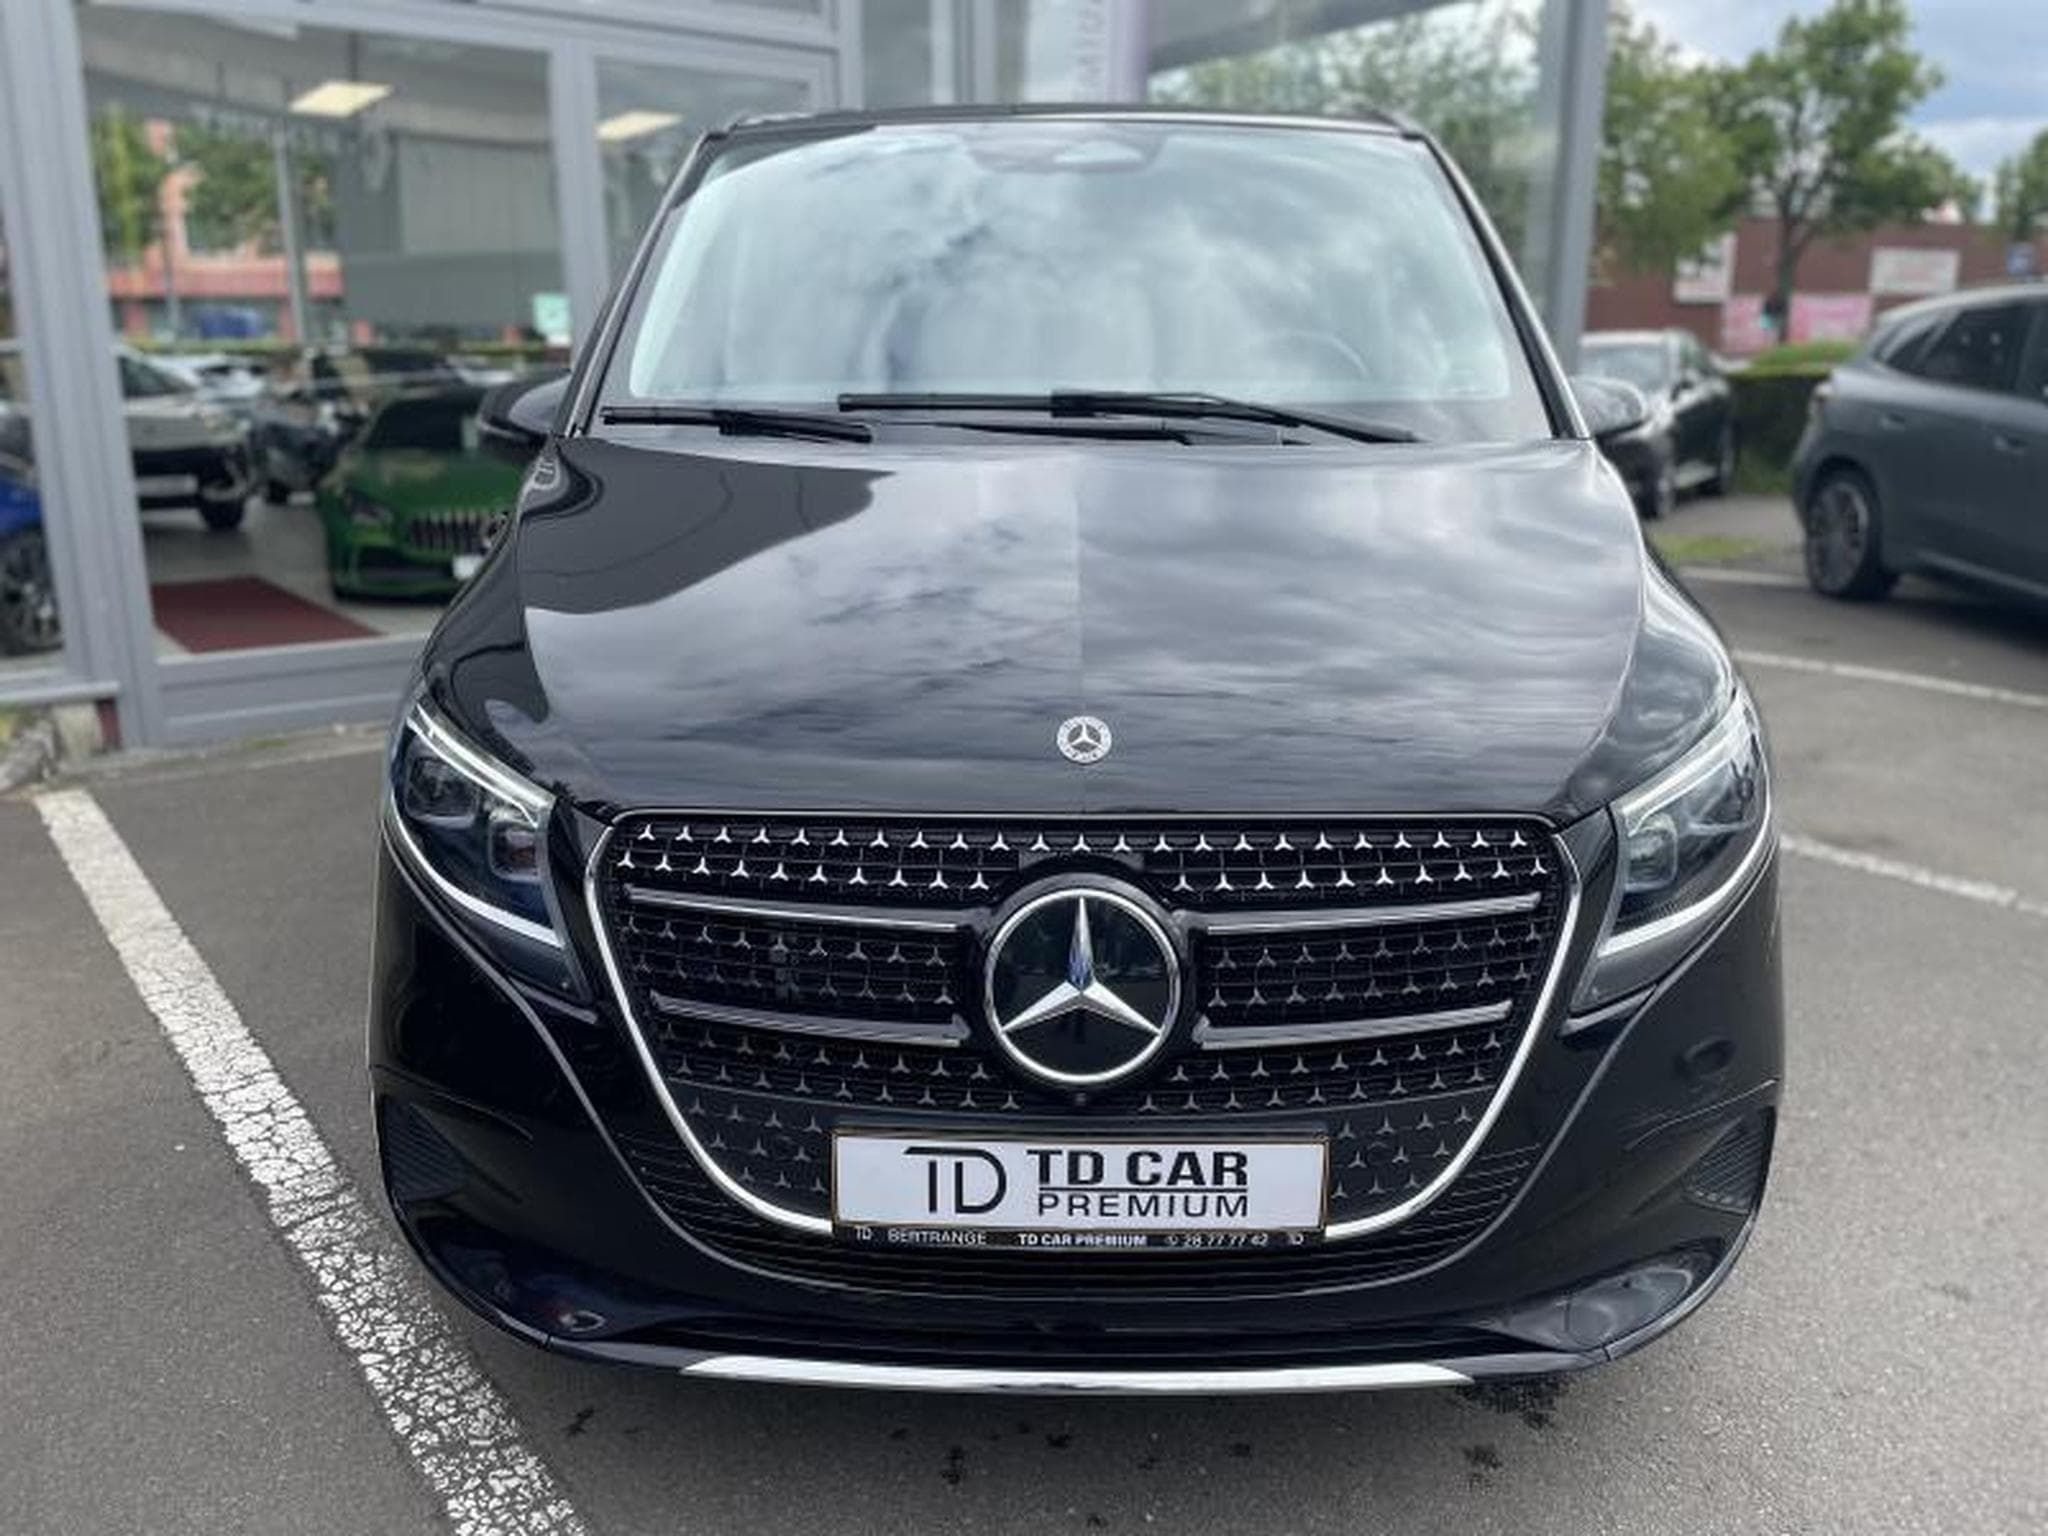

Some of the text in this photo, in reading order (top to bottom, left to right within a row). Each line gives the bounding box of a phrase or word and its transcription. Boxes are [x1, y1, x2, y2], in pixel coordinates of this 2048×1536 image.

[1027, 1149, 1248, 1186] TD CAR
[904, 1147, 1007, 1214] TD
[1038, 1193, 1248, 1217] PREMIUM
[888, 1229, 987, 1245] BERTRANGE
[1018, 1233, 1147, 1246] TD CAR PREMIUM
